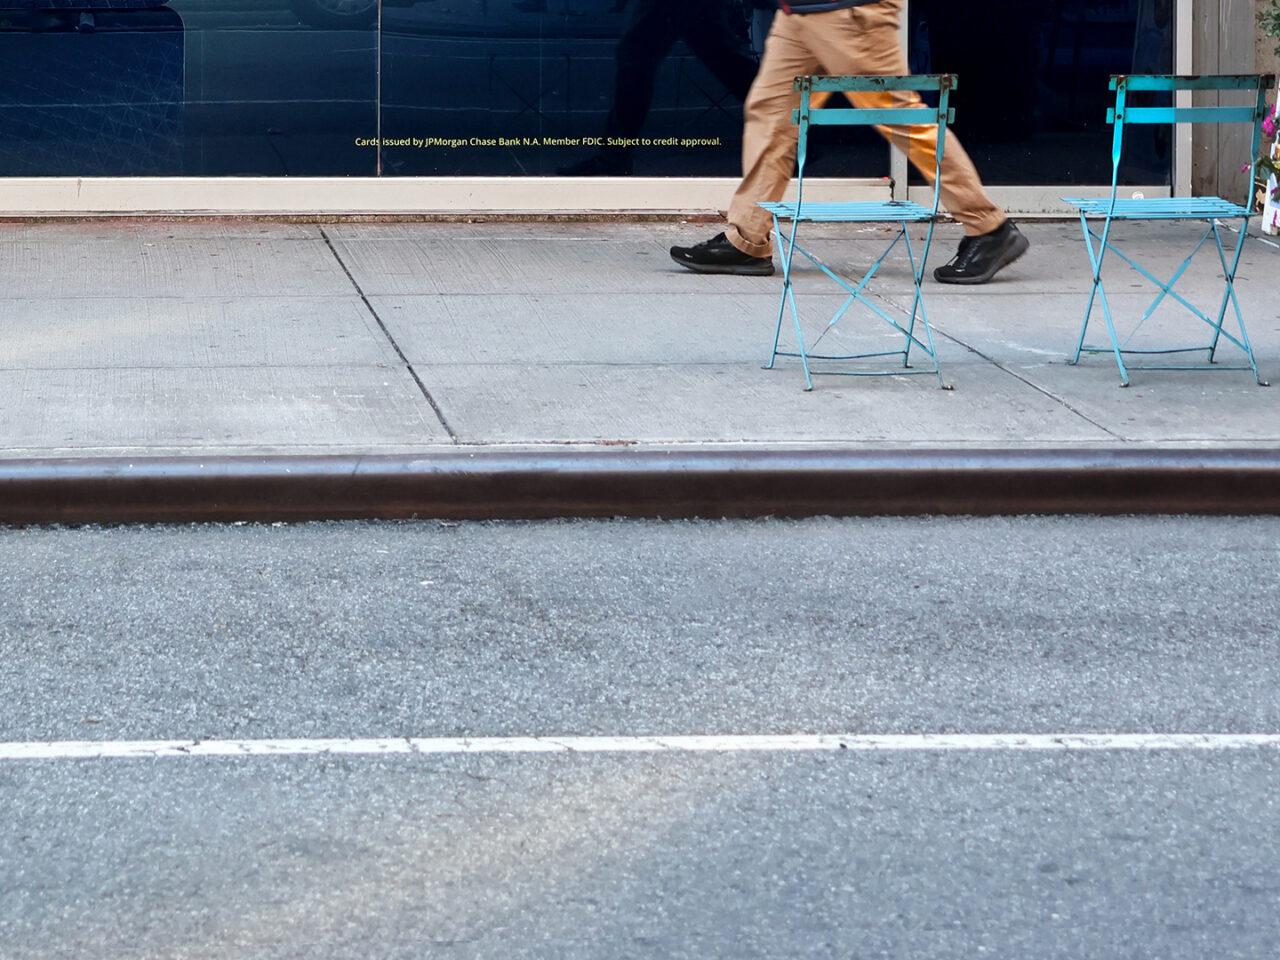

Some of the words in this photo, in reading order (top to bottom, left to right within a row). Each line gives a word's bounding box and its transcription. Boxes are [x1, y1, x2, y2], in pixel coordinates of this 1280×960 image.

[355, 137, 381, 146] Cards
[382, 137, 411, 146] issued
[413, 137, 424, 148] by
[424, 137, 468, 148] JPMorgan
[470, 137, 497, 146] Chase
[498, 137, 521, 146] Bank
[522, 138, 541, 146] N.A.
[543, 137, 581, 146] Member
[582, 137, 606, 146] FDIC.
[607, 137, 640, 148] Subject
[641, 138, 652, 146] to
[653, 137, 679, 146] credit
[680, 137, 722, 148] approval.
